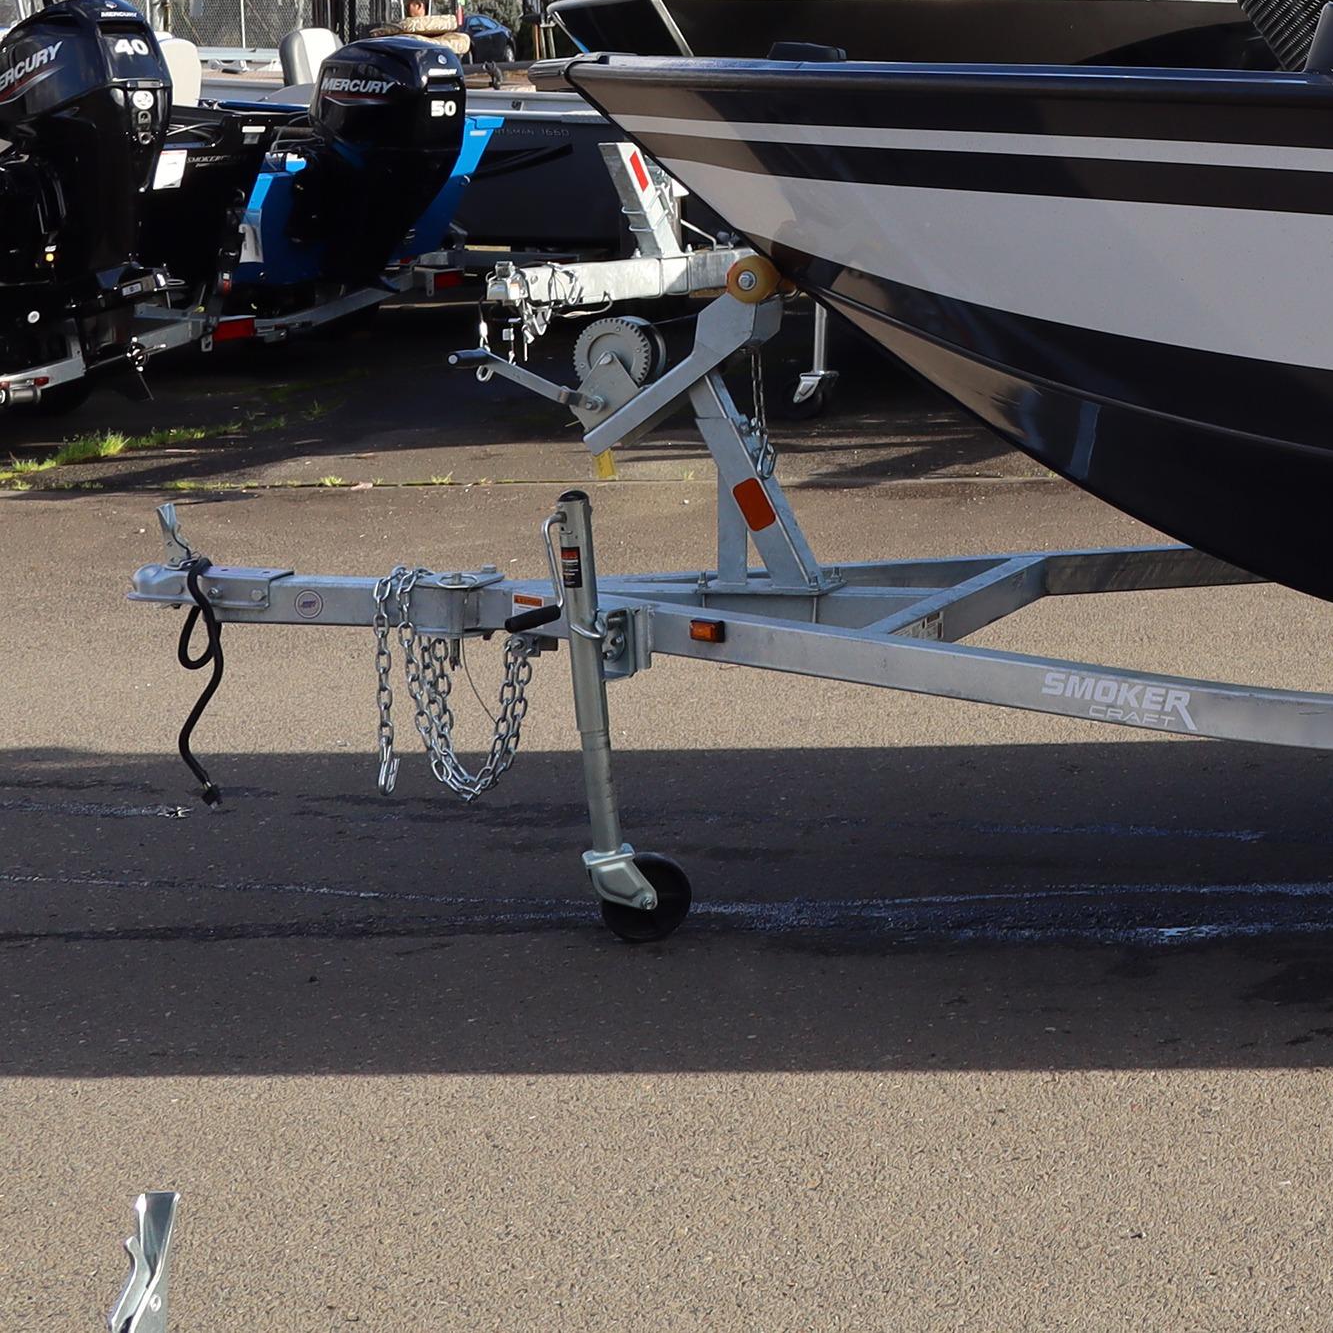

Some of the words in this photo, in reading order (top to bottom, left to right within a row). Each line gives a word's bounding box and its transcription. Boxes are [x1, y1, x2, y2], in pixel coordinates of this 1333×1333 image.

[115, 39, 149, 55] 40
[321, 78, 394, 94] MERCURY
[431, 100, 456, 117] 50
[1042, 672, 1197, 730] SMOKER
[1089, 705, 1177, 728] CRAFT
